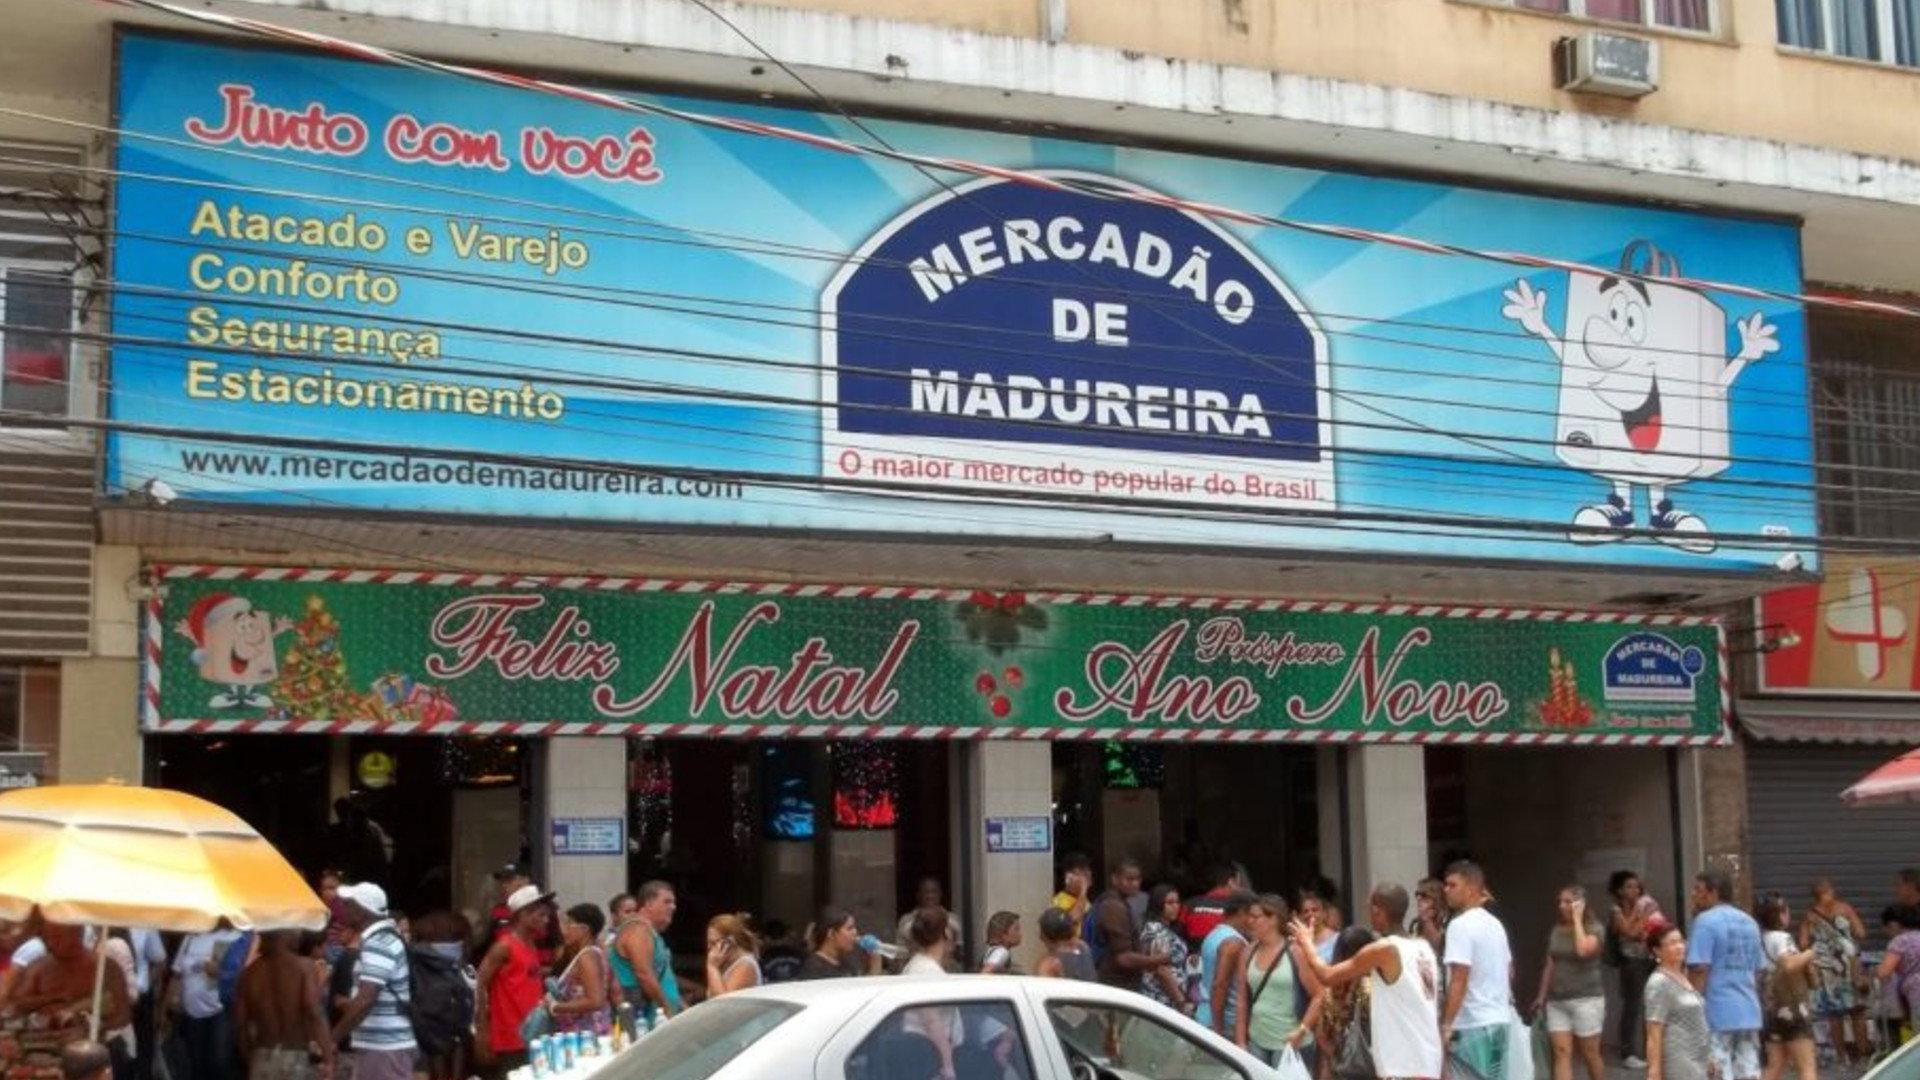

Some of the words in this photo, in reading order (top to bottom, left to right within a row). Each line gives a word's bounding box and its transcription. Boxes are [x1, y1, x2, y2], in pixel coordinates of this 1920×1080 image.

[186, 84, 368, 156] Junto
[386, 117, 506, 170] com
[522, 130, 661, 182] você
[190, 201, 388, 252] Atacado
[405, 227, 432, 255] e
[449, 222, 590, 275] Varejo
[189, 254, 399, 305] Conforto
[908, 216, 1256, 325] MERCADÃO
[188, 307, 441, 363] Segurança
[1052, 299, 1129, 346] DE
[186, 361, 566, 421] Estacionamento
[910, 368, 1272, 438] MADUREIRA
[182, 450, 743, 498] www.mercadaodemadureira.com
[838, 450, 862, 476] O
[872, 456, 952, 480] maior
[963, 461, 1085, 487] mercado
[1094, 467, 1195, 496] popular
[1204, 473, 1236, 494] do
[425, 594, 619, 680] Feliz
[592, 600, 921, 720] Natal
[1053, 618, 1261, 723] Ano
[1286, 626, 1509, 728] Novo
[1196, 616, 1346, 678] Próspero
